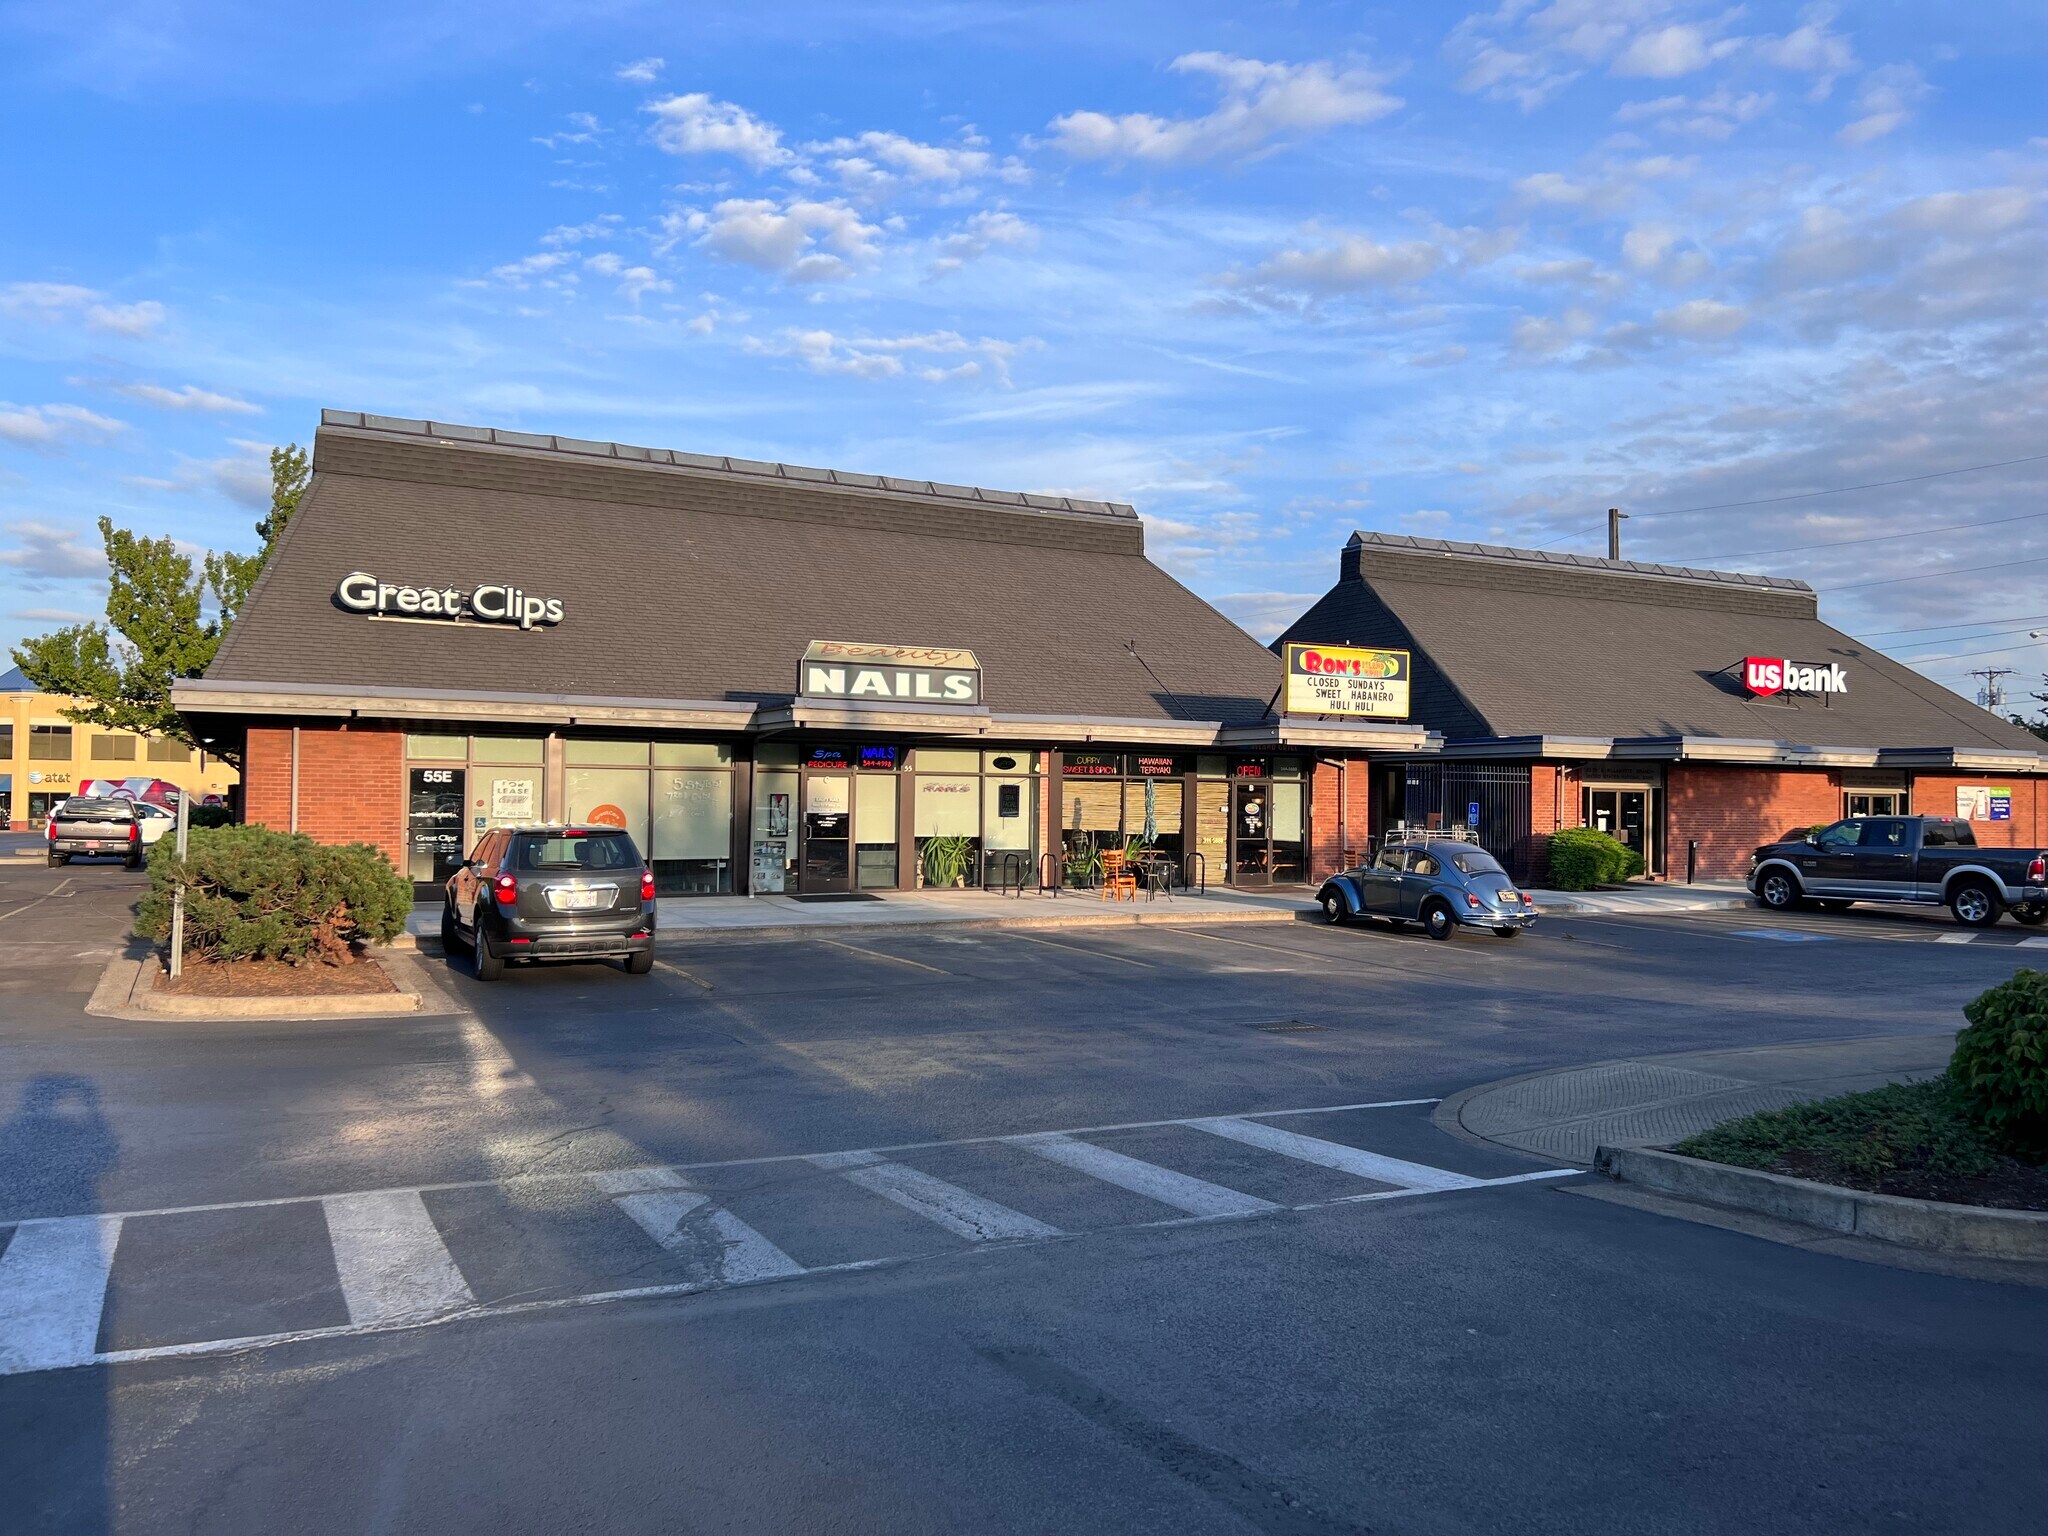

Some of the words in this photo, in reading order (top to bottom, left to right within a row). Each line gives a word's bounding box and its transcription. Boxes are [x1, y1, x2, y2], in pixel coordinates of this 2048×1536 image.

[339, 573, 461, 616] Great
[472, 583, 564, 629] Clips
[820, 642, 962, 666] Beauty
[808, 667, 973, 700] NAILS
[1307, 677, 1340, 688] CLOSED
[1347, 679, 1385, 691] SUNDAYS
[1315, 688, 1342, 699] SWEET
[1350, 690, 1394, 702] HABANERO
[1329, 700, 1350, 711] HULI
[1354, 701, 1374, 712] HULI
[812, 749, 842, 760] Spa
[861, 747, 895, 759] NAILS
[807, 760, 848, 769] PEDICURE
[1076, 756, 1101, 765] CURRY
[1138, 757, 1173, 766] HAWAIIAN
[1063, 765, 1088, 774] SWEET
[1095, 765, 1116, 775] SPICY
[1139, 765, 1171, 774] TERIYAKI
[1236, 765, 1261, 777] OPEN
[44, 772, 71, 783] at&t
[422, 770, 453, 783] 55E
[497, 787, 529, 795] LEASE
[1248, 784, 1254, 792] B
[415, 834, 438, 842] Great
[438, 834, 459, 843] Clips
